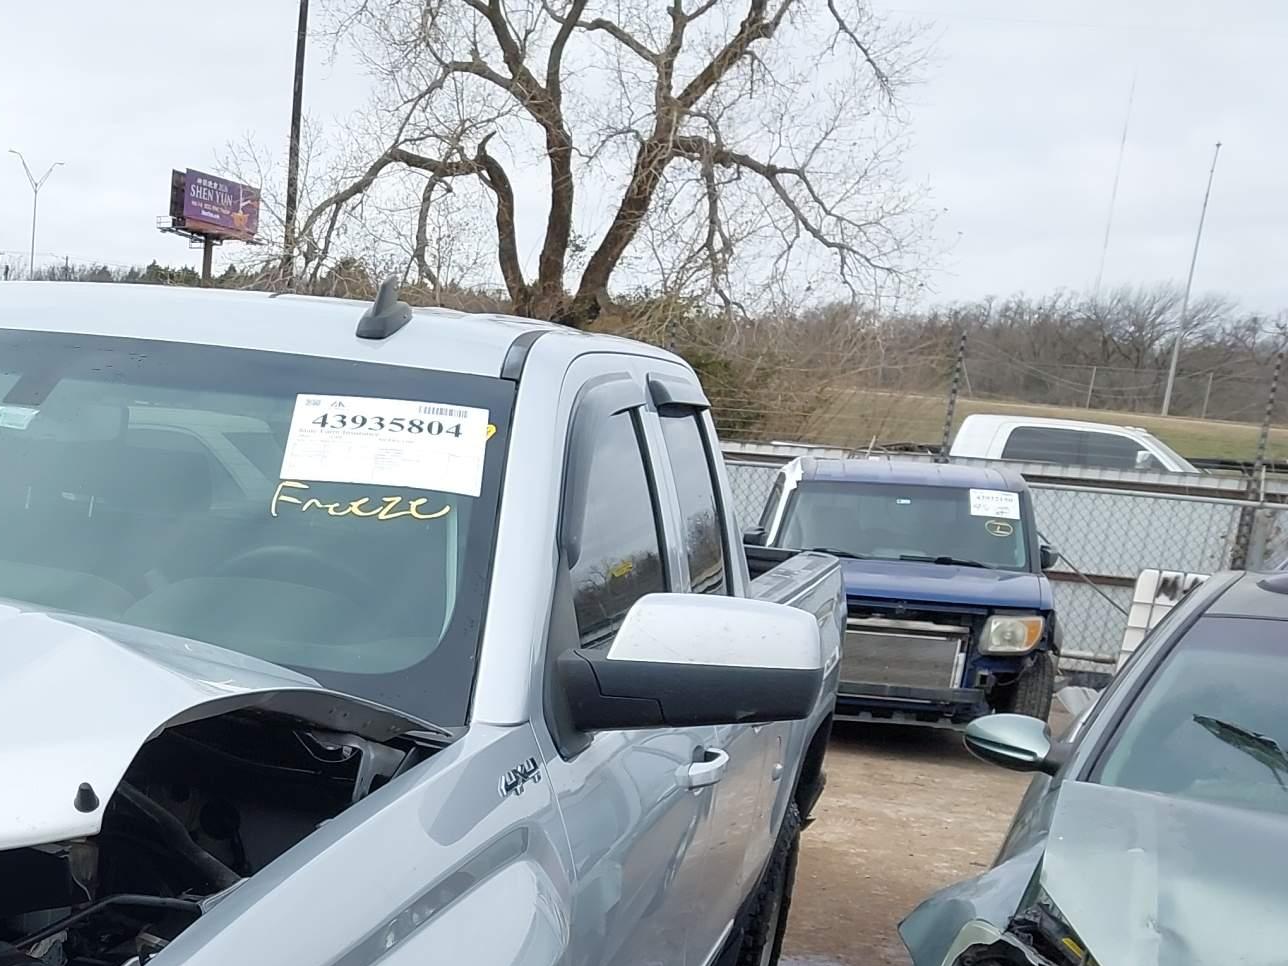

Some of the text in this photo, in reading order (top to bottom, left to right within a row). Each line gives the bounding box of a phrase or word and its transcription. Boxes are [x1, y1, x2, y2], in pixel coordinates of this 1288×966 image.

[190, 184, 213, 201] SHEN
[215, 191, 233, 206] YUN
[312, 412, 463, 438] 43935804
[270, 481, 451, 520] Freeze
